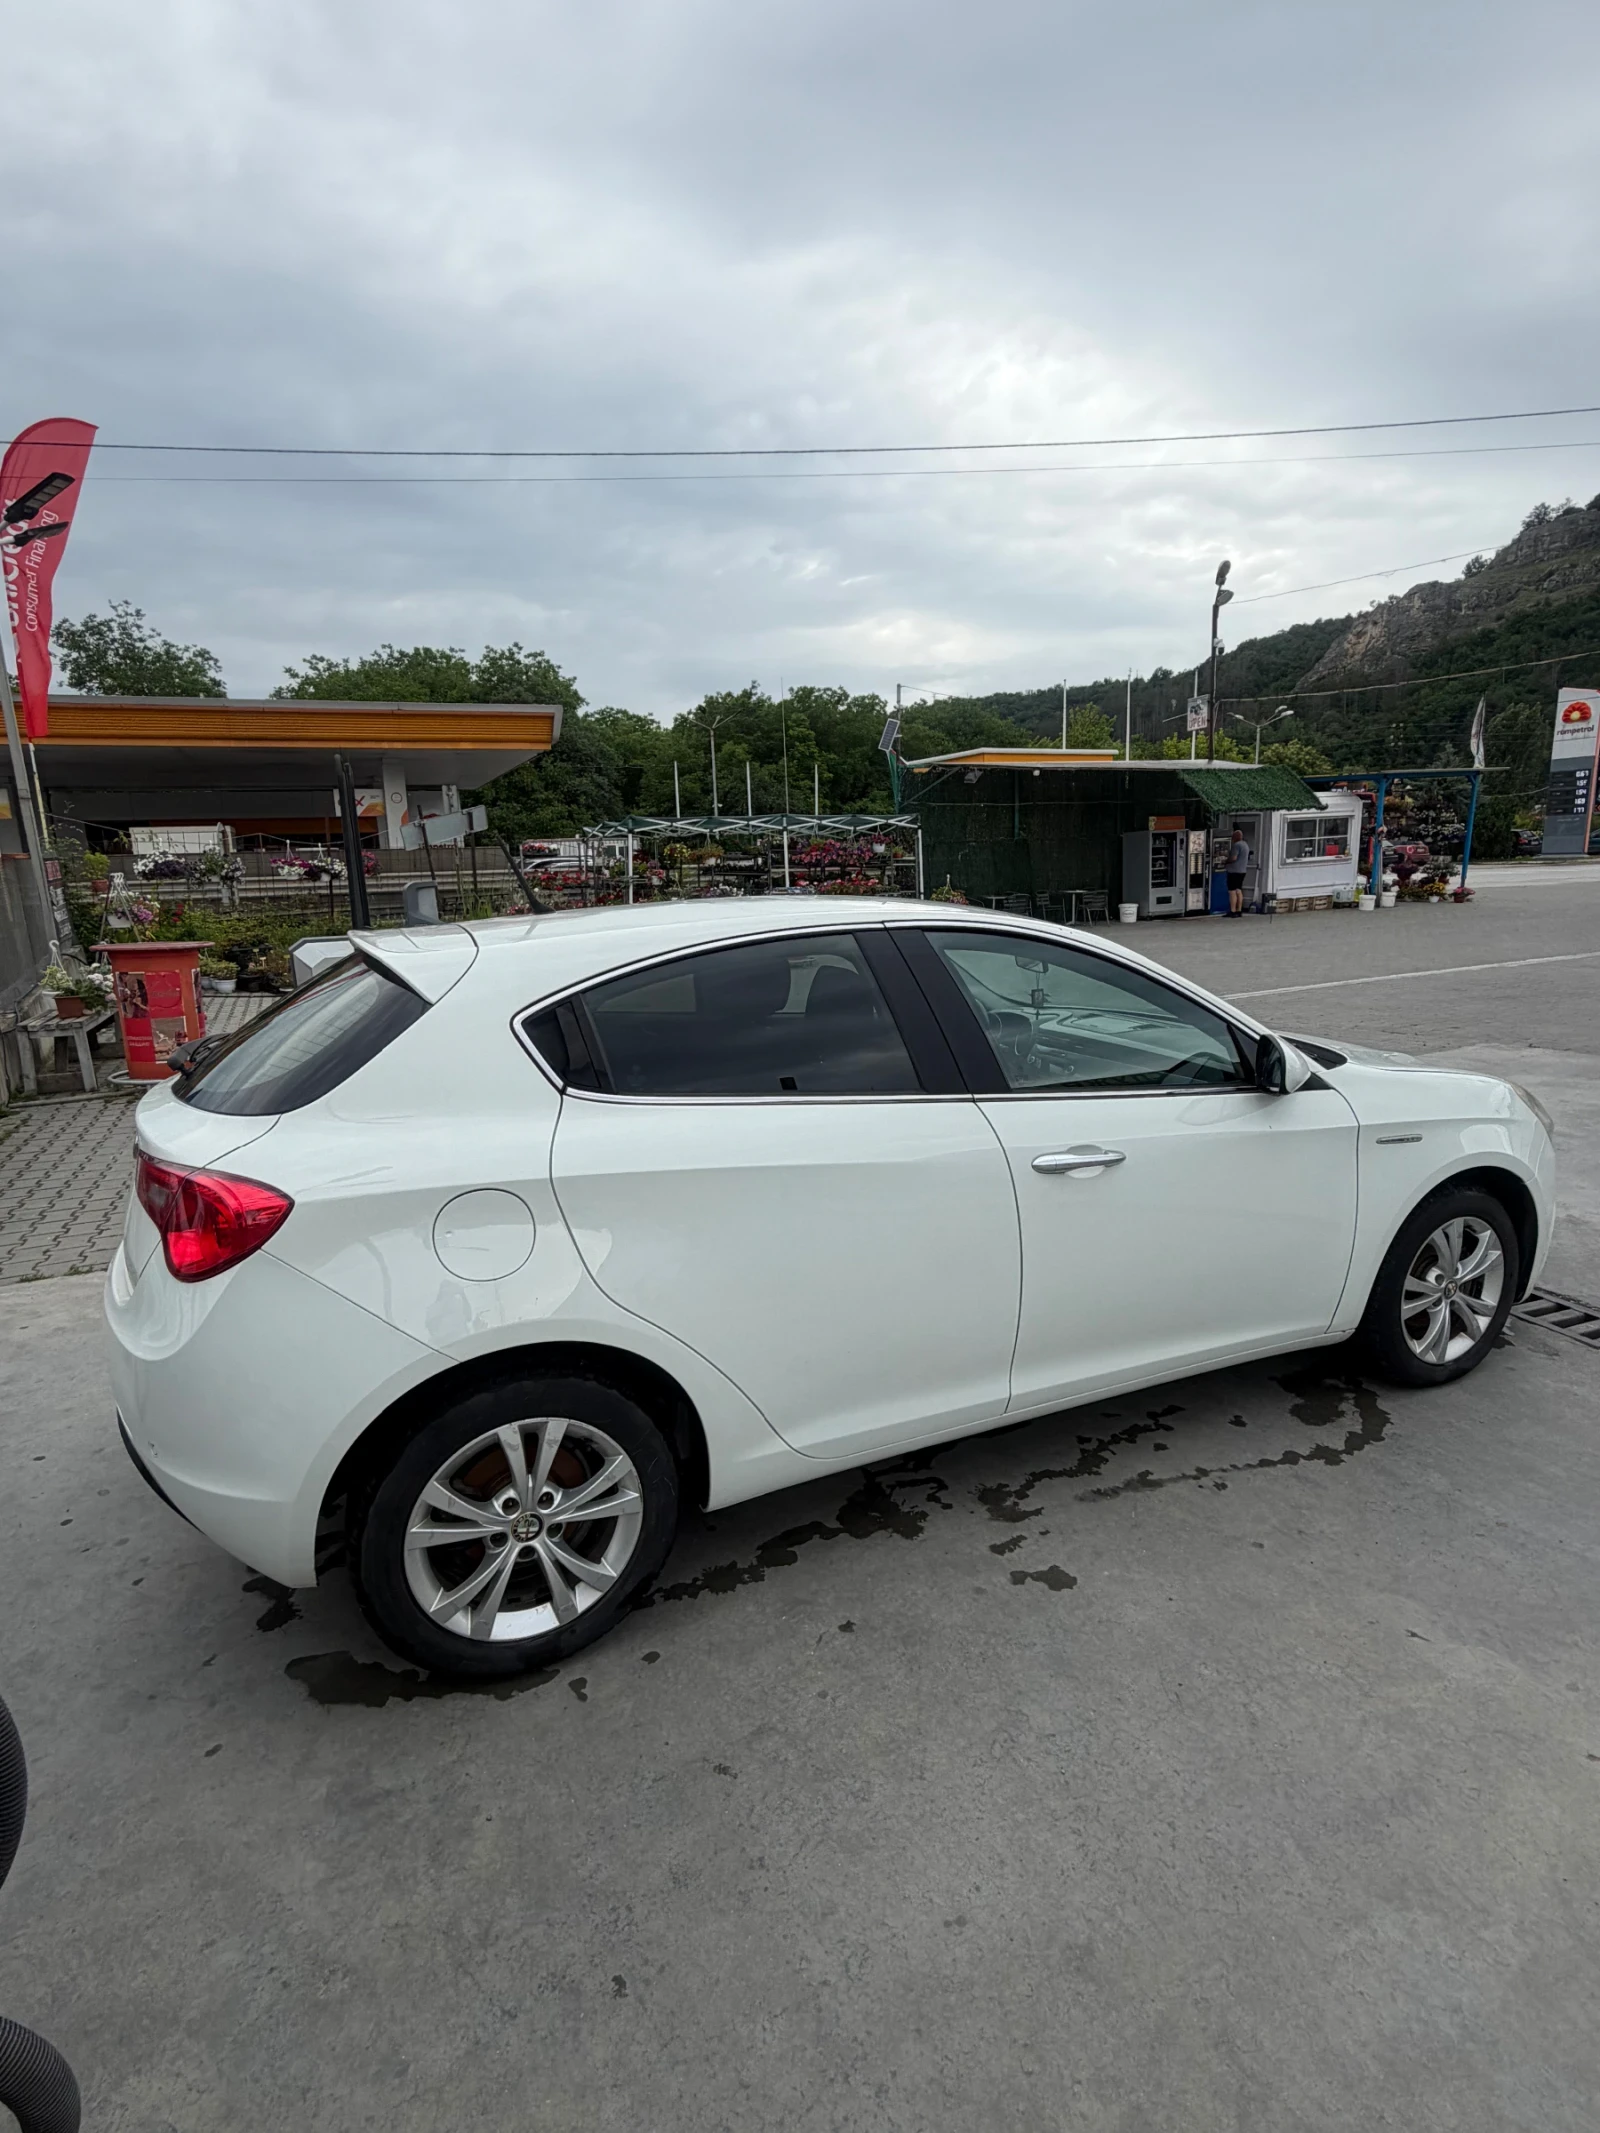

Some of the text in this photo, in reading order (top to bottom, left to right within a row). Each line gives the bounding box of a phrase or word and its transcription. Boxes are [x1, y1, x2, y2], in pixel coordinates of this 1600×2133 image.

[25, 509, 59, 632] Consumer Finang
[1189, 716, 1206, 728] OPEN
[1557, 725, 1594, 736] rompetrol
